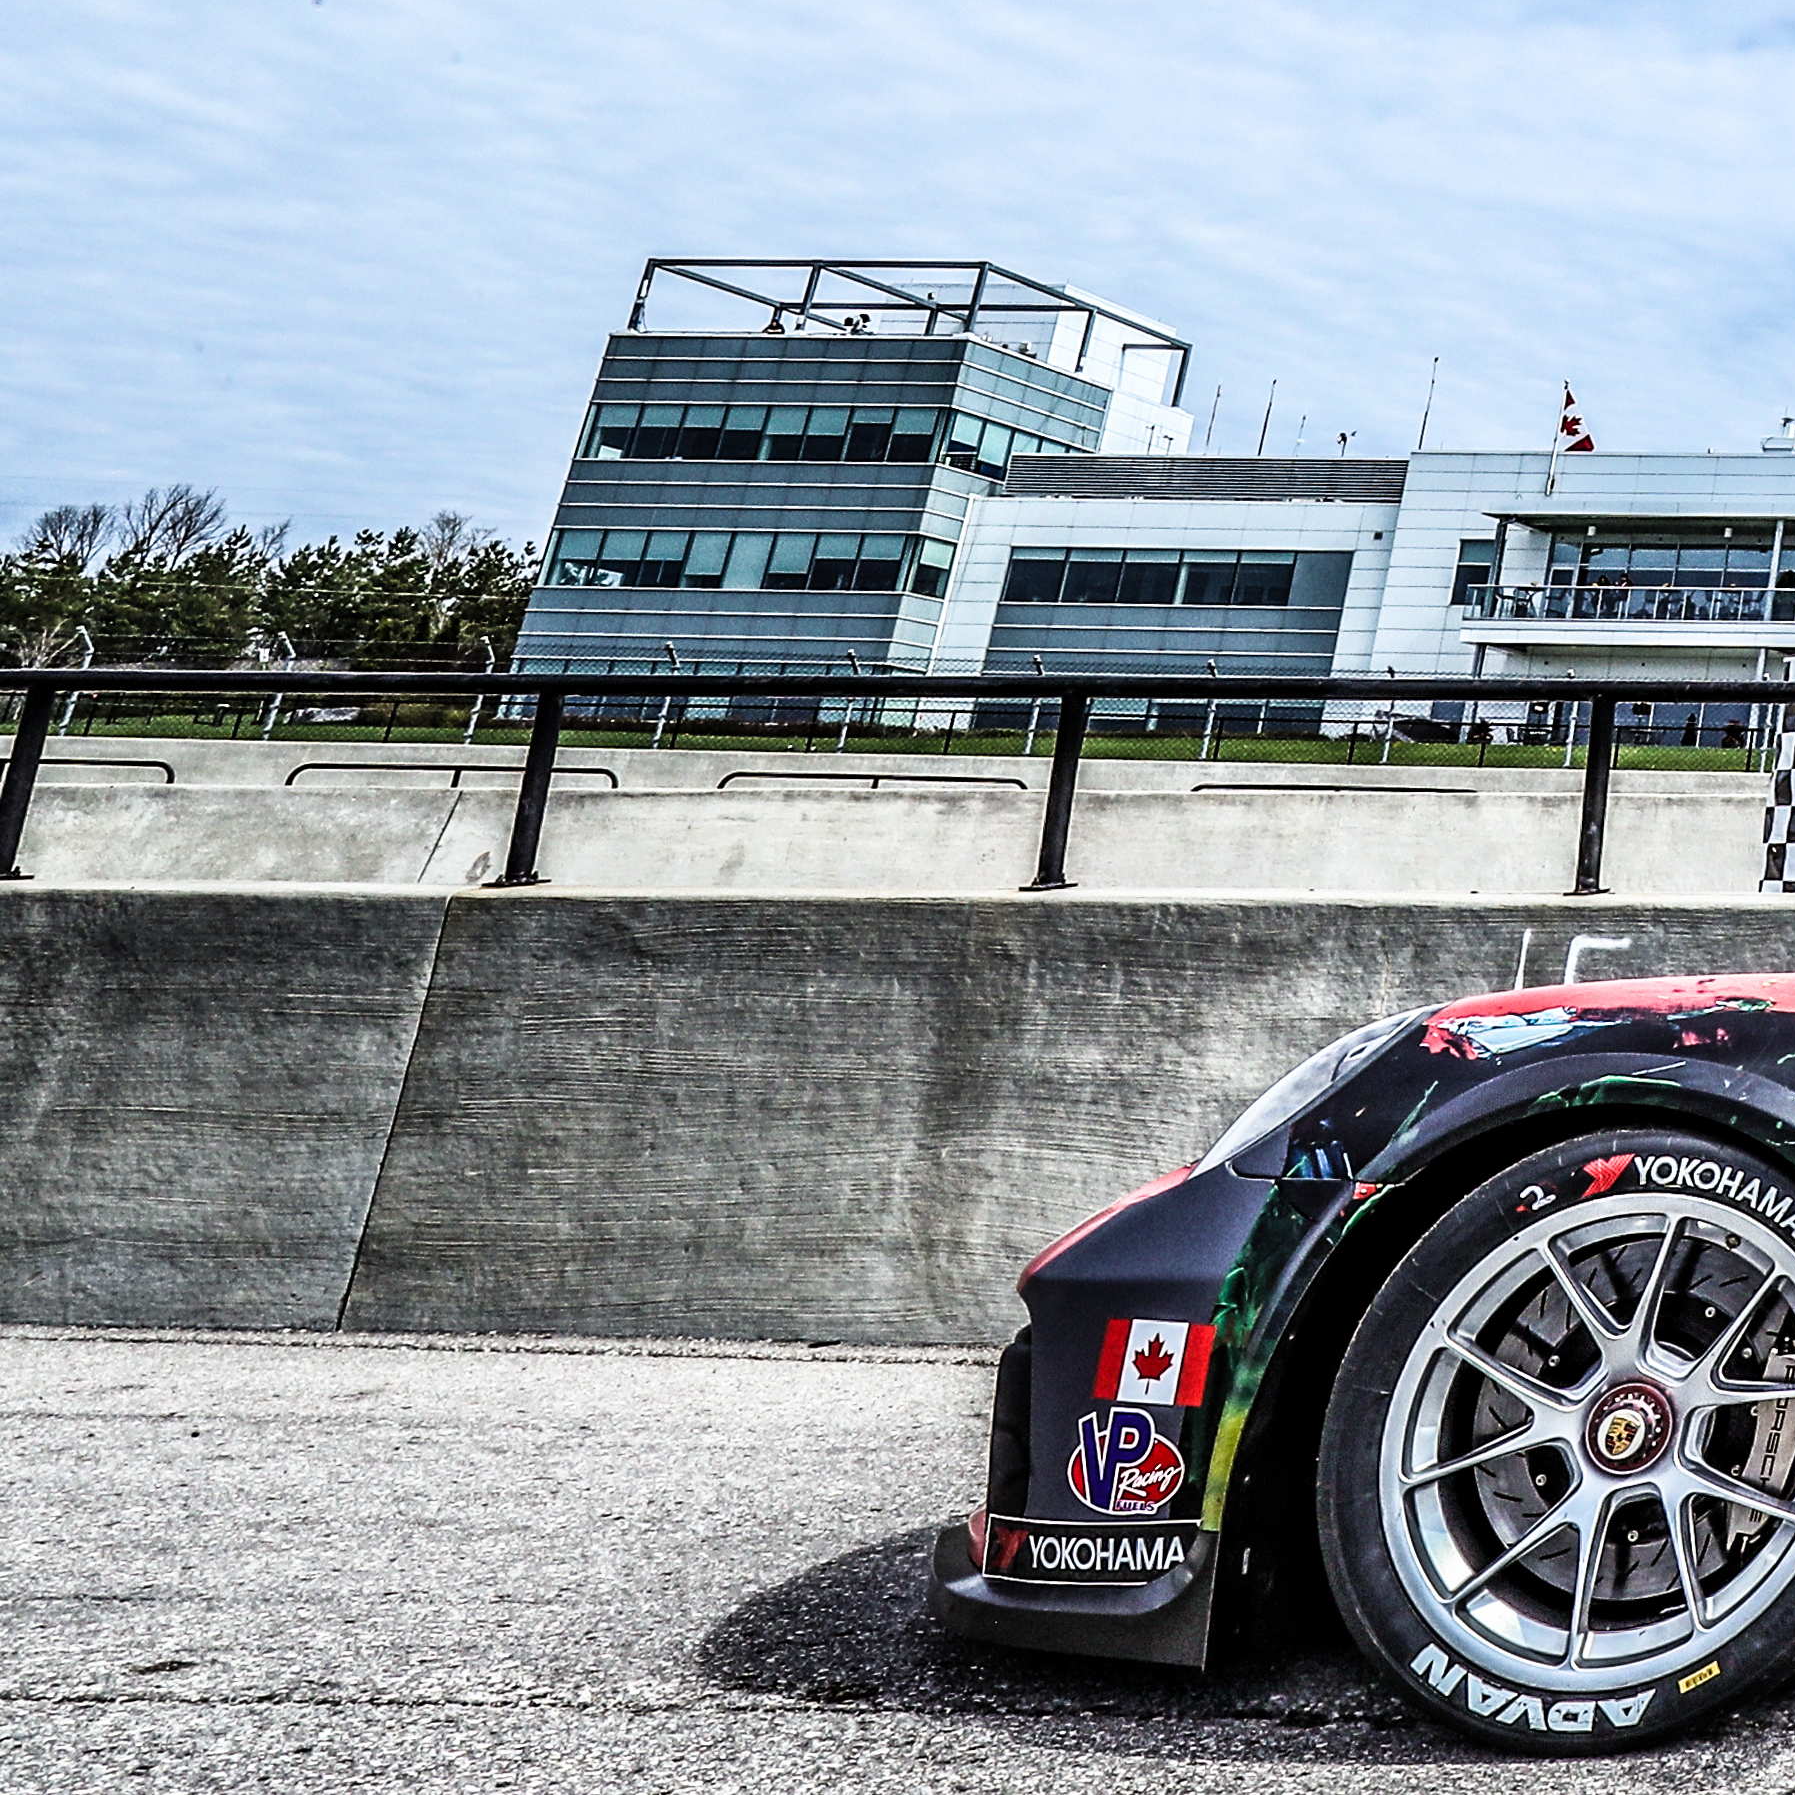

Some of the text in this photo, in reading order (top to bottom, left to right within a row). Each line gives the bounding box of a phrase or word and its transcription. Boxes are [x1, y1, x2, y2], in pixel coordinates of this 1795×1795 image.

[1078, 1406, 1154, 1513] VP
[1119, 1464, 1185, 1497] Racing
[1114, 1499, 1157, 1513] FUELS
[1028, 1535, 1186, 1572] YOKOHAMA
[1410, 1642, 1657, 1733] ADVAN
